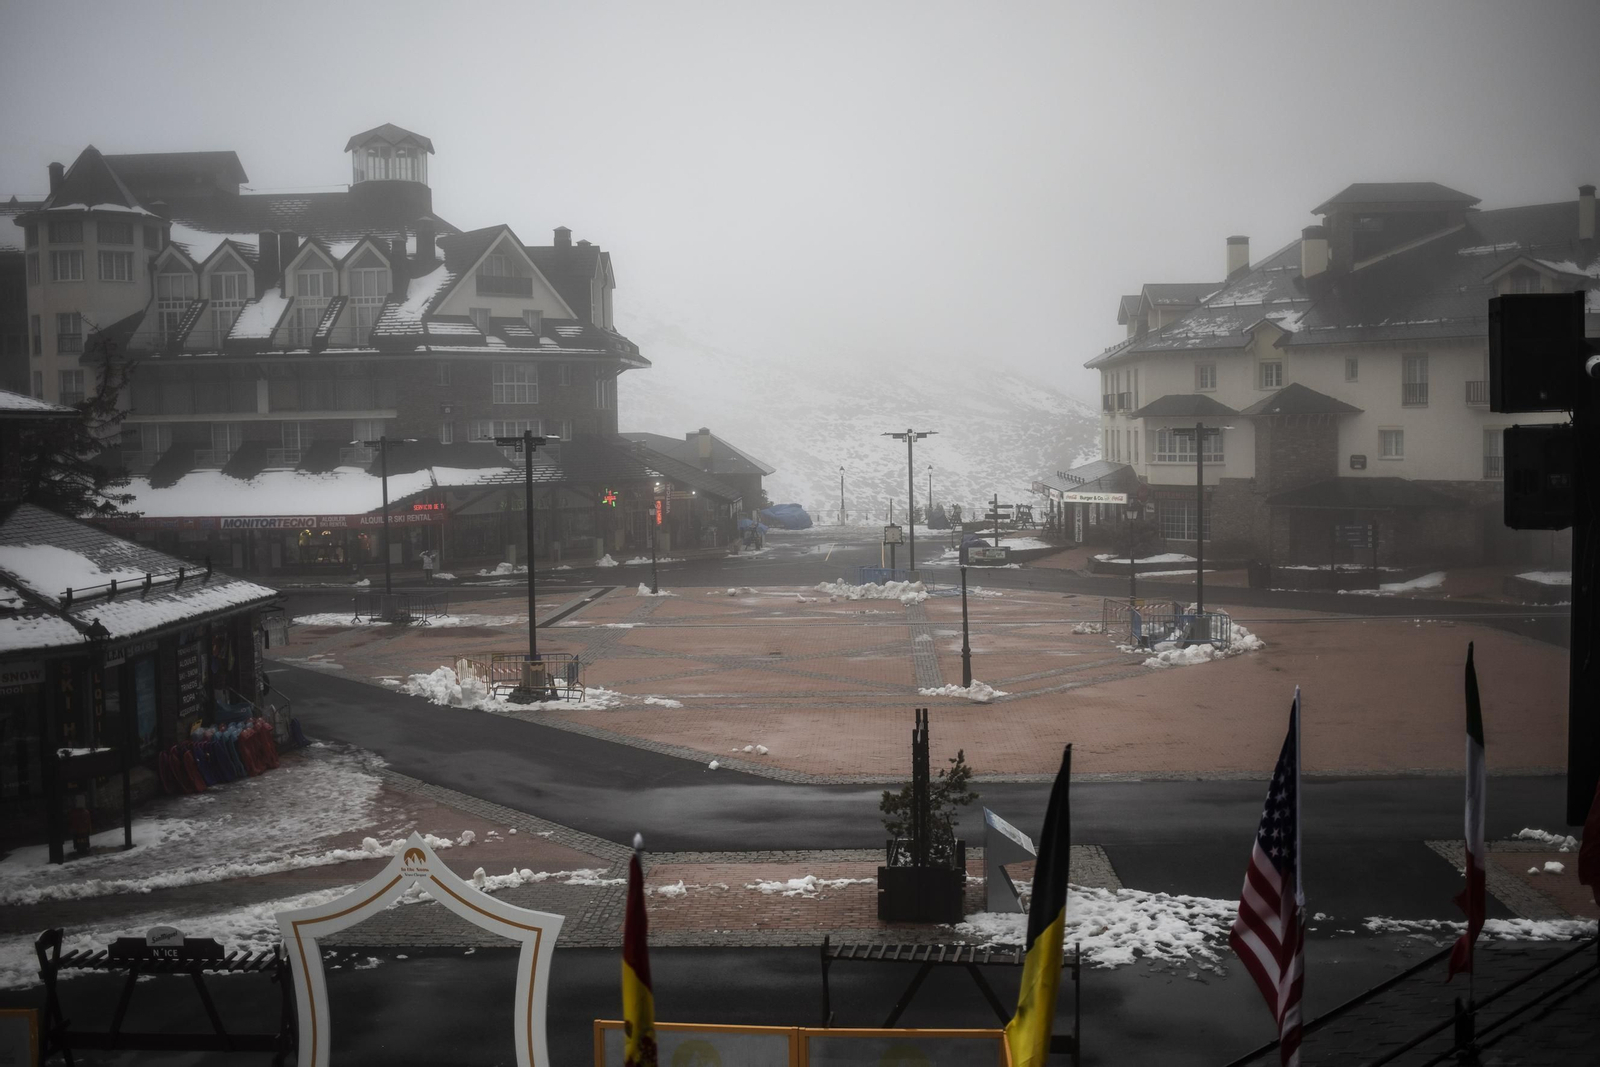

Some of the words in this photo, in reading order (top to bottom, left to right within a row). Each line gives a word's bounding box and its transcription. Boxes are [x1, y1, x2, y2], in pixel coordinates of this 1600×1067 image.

[1080, 494, 1093, 502] Burger
[223, 518, 314, 528] MONITORTECNO
[360, 515, 393, 524] ALQUILR
[393, 515, 405, 523] SKI
[406, 514, 432, 522] RENTAL
[2, 669, 41, 683] SNOW
